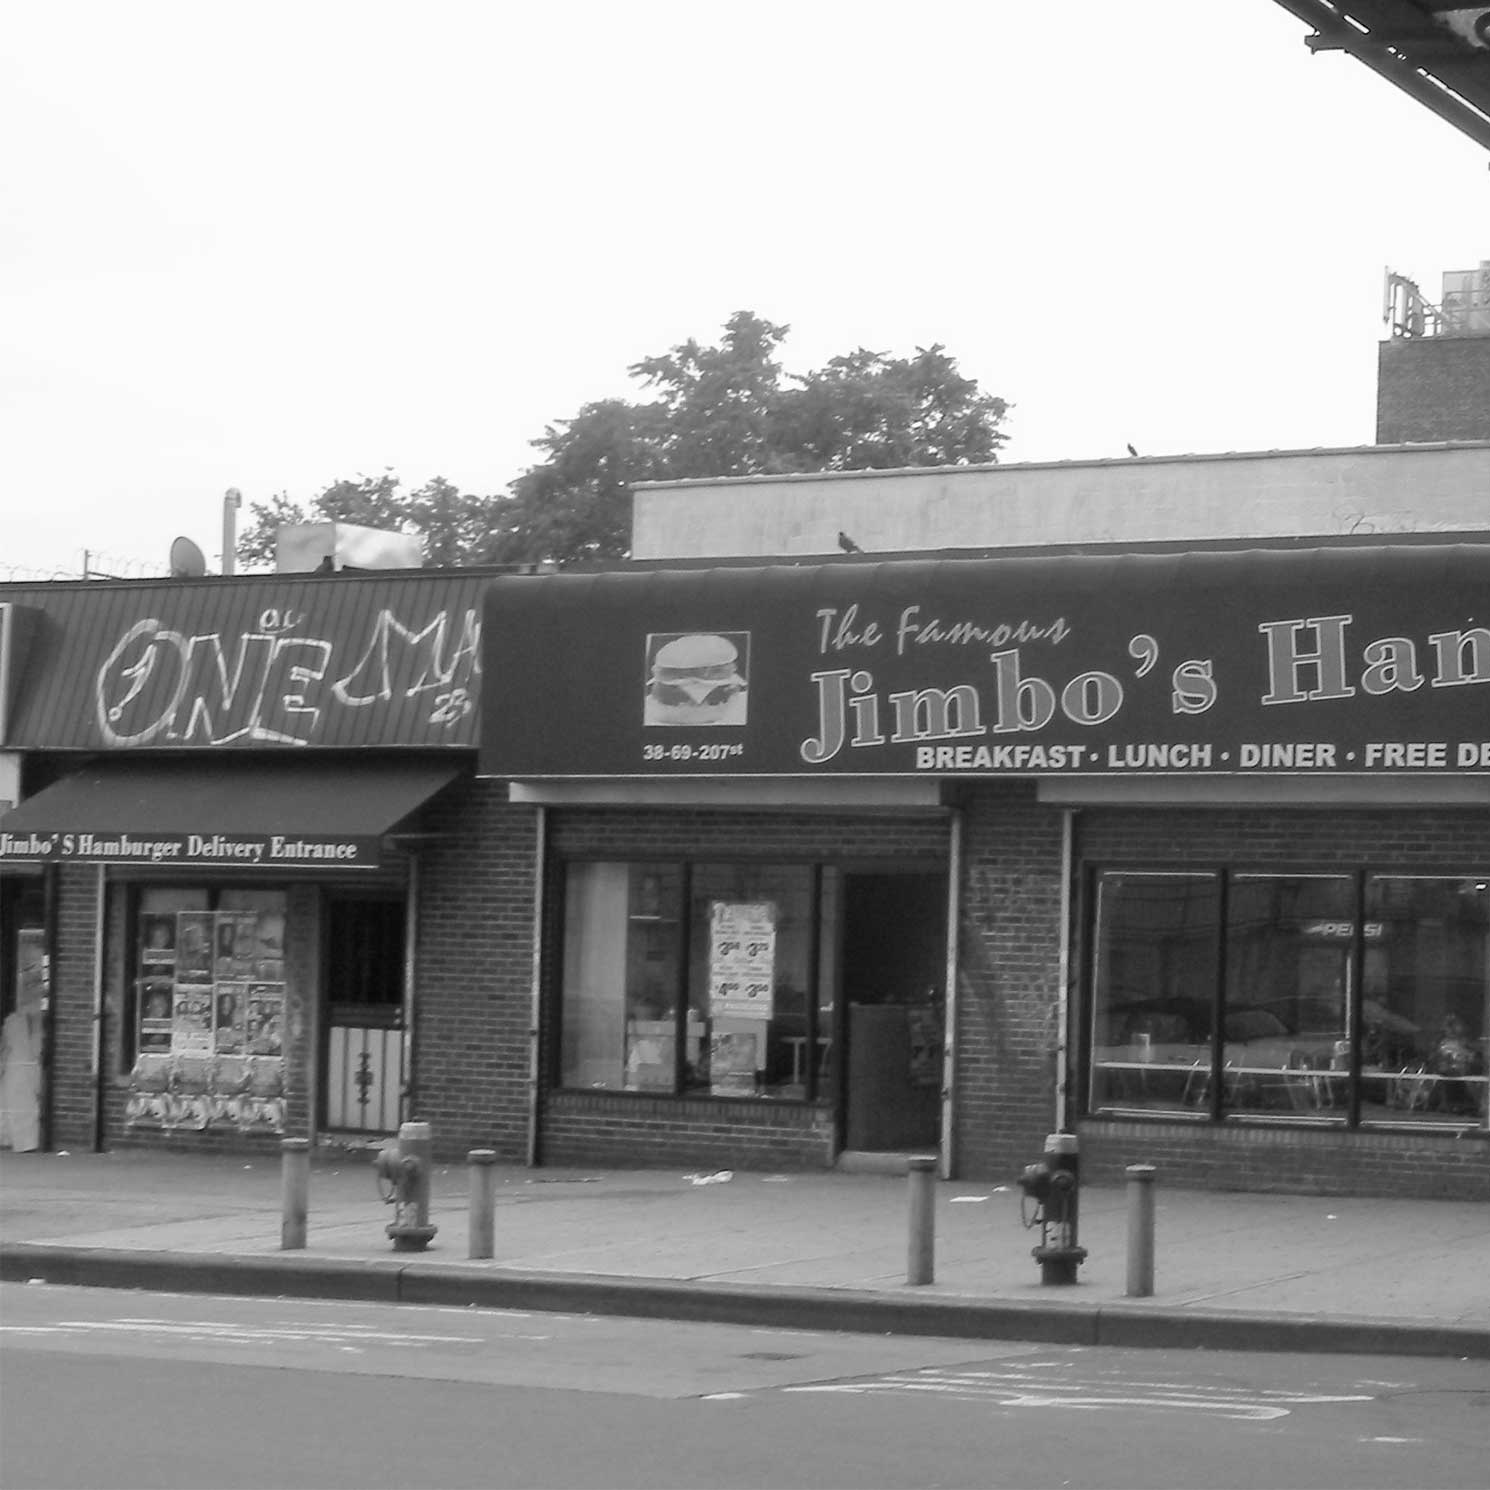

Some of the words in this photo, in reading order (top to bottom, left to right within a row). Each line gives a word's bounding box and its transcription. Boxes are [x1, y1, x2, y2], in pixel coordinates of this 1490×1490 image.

[816, 604, 882, 653] The
[897, 605, 1071, 655] Famous
[800, 633, 1218, 763] Jimbo's
[643, 743, 743, 760] 38-69-207st
[916, 745, 1084, 770] BREAKFAST
[1108, 744, 1212, 768] LUNCH
[1240, 743, 1337, 768] DINER
[1364, 743, 1447, 768] FREE
[78, 834, 182, 861] Hamburger
[187, 835, 265, 863] Delivery
[269, 836, 358, 859] Entrance
[1321, 922, 1384, 937] PESI
